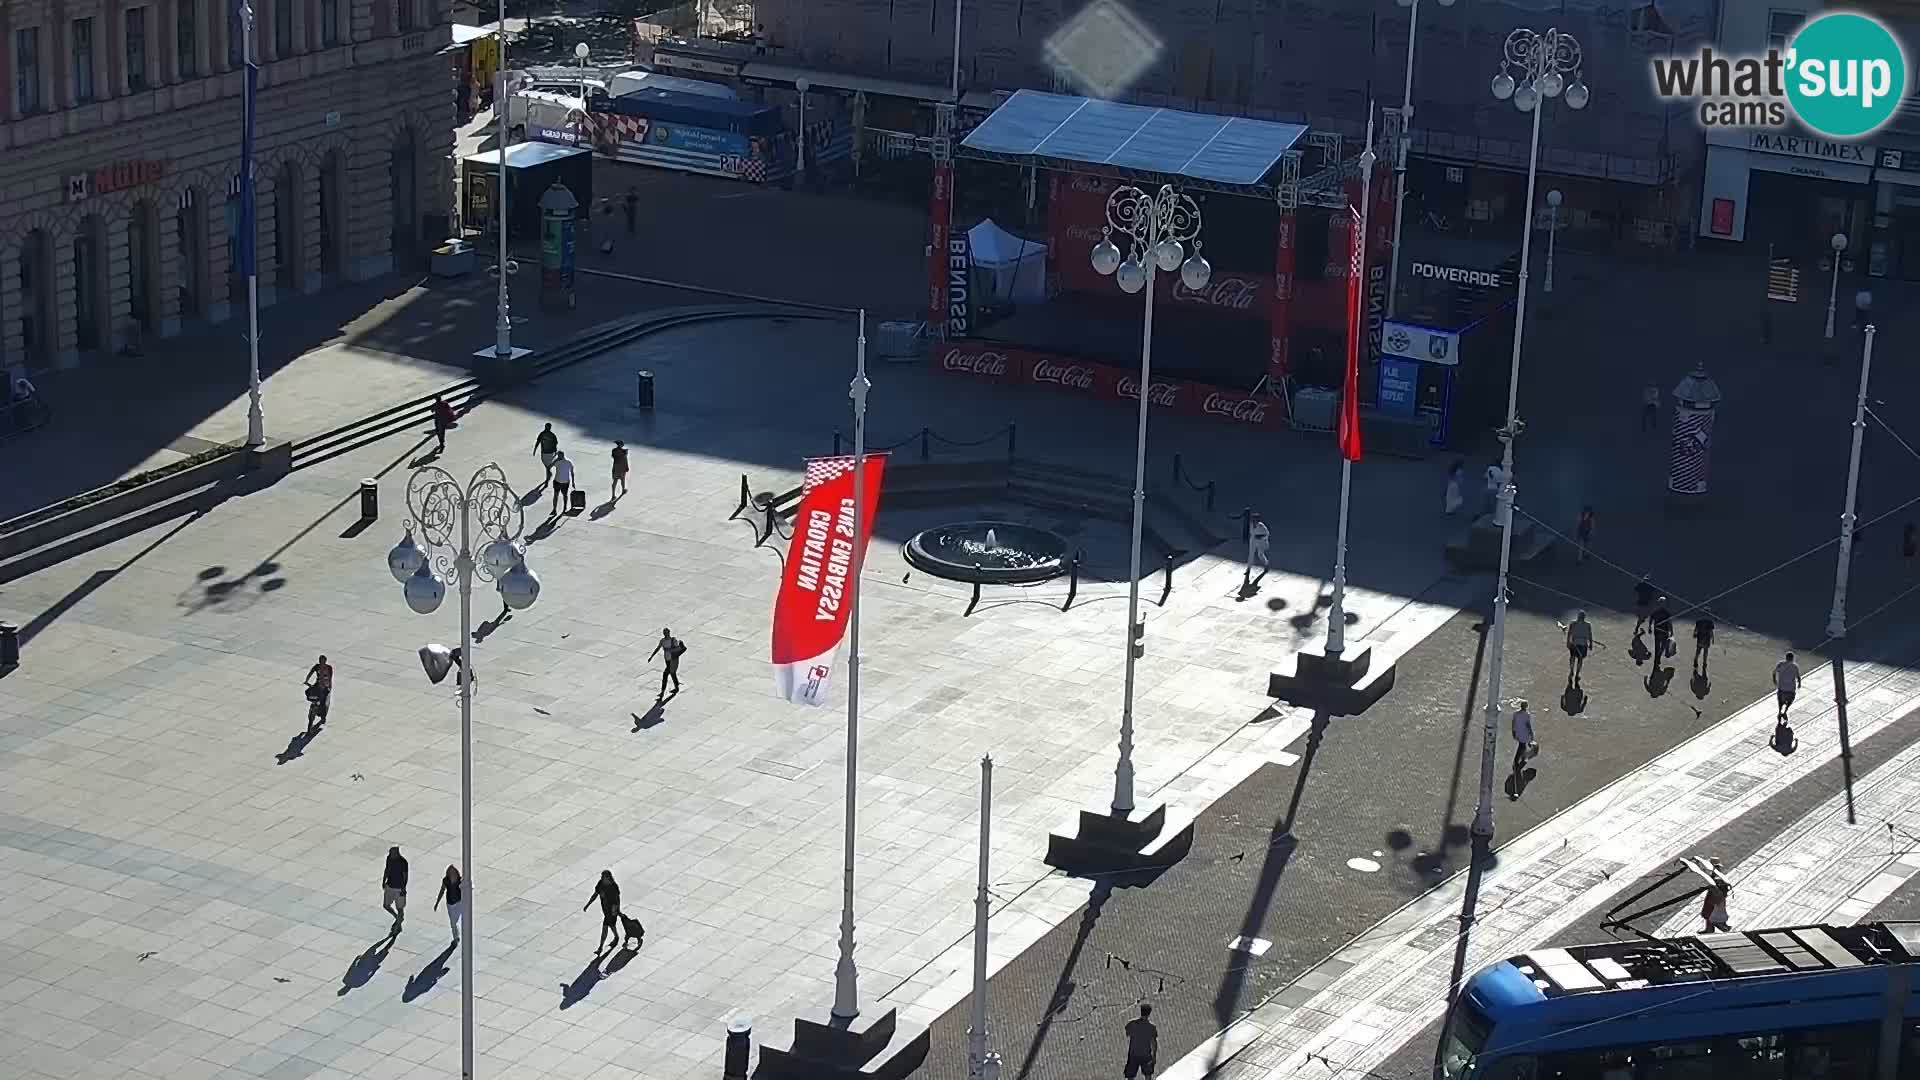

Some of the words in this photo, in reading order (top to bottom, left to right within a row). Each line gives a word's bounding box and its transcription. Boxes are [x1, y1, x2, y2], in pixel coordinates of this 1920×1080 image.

[1753, 132, 1866, 162] MARTIMEX
[96, 160, 172, 193] Mülle
[1789, 166, 1826, 178] CHANEL
[1411, 262, 1501, 288] POWERADE
